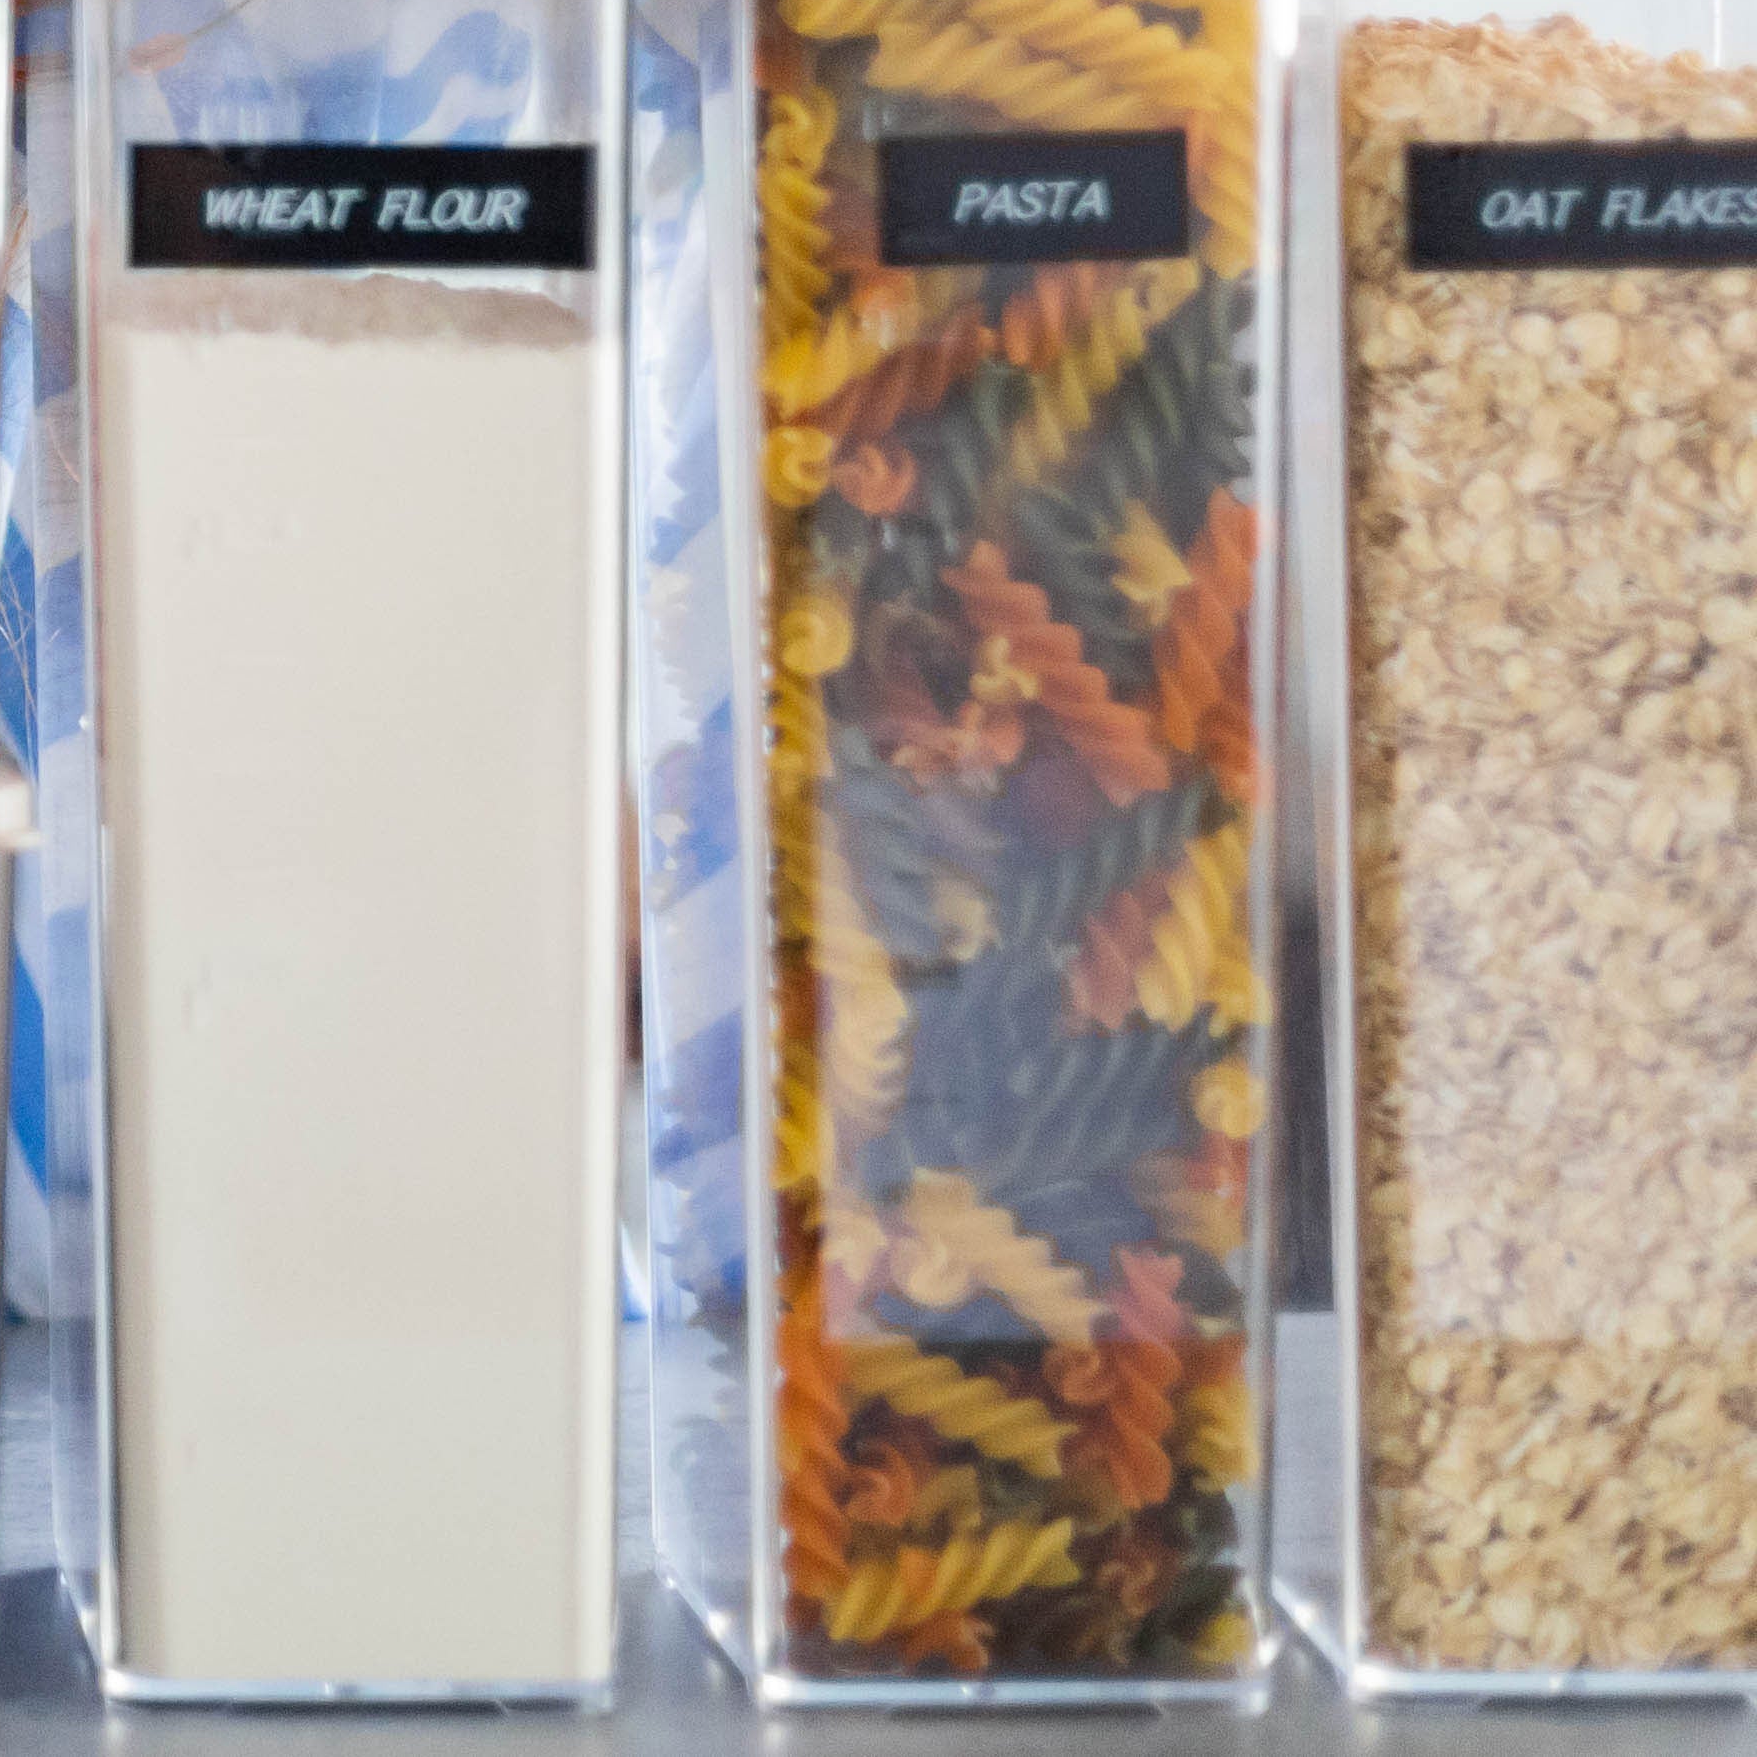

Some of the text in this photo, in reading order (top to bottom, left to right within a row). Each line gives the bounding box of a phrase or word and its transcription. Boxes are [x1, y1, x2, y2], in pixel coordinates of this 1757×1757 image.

[204, 186, 527, 231] WHEAT FLOUR
[952, 179, 1110, 223] PASTA
[1480, 187, 1583, 230] OAT
